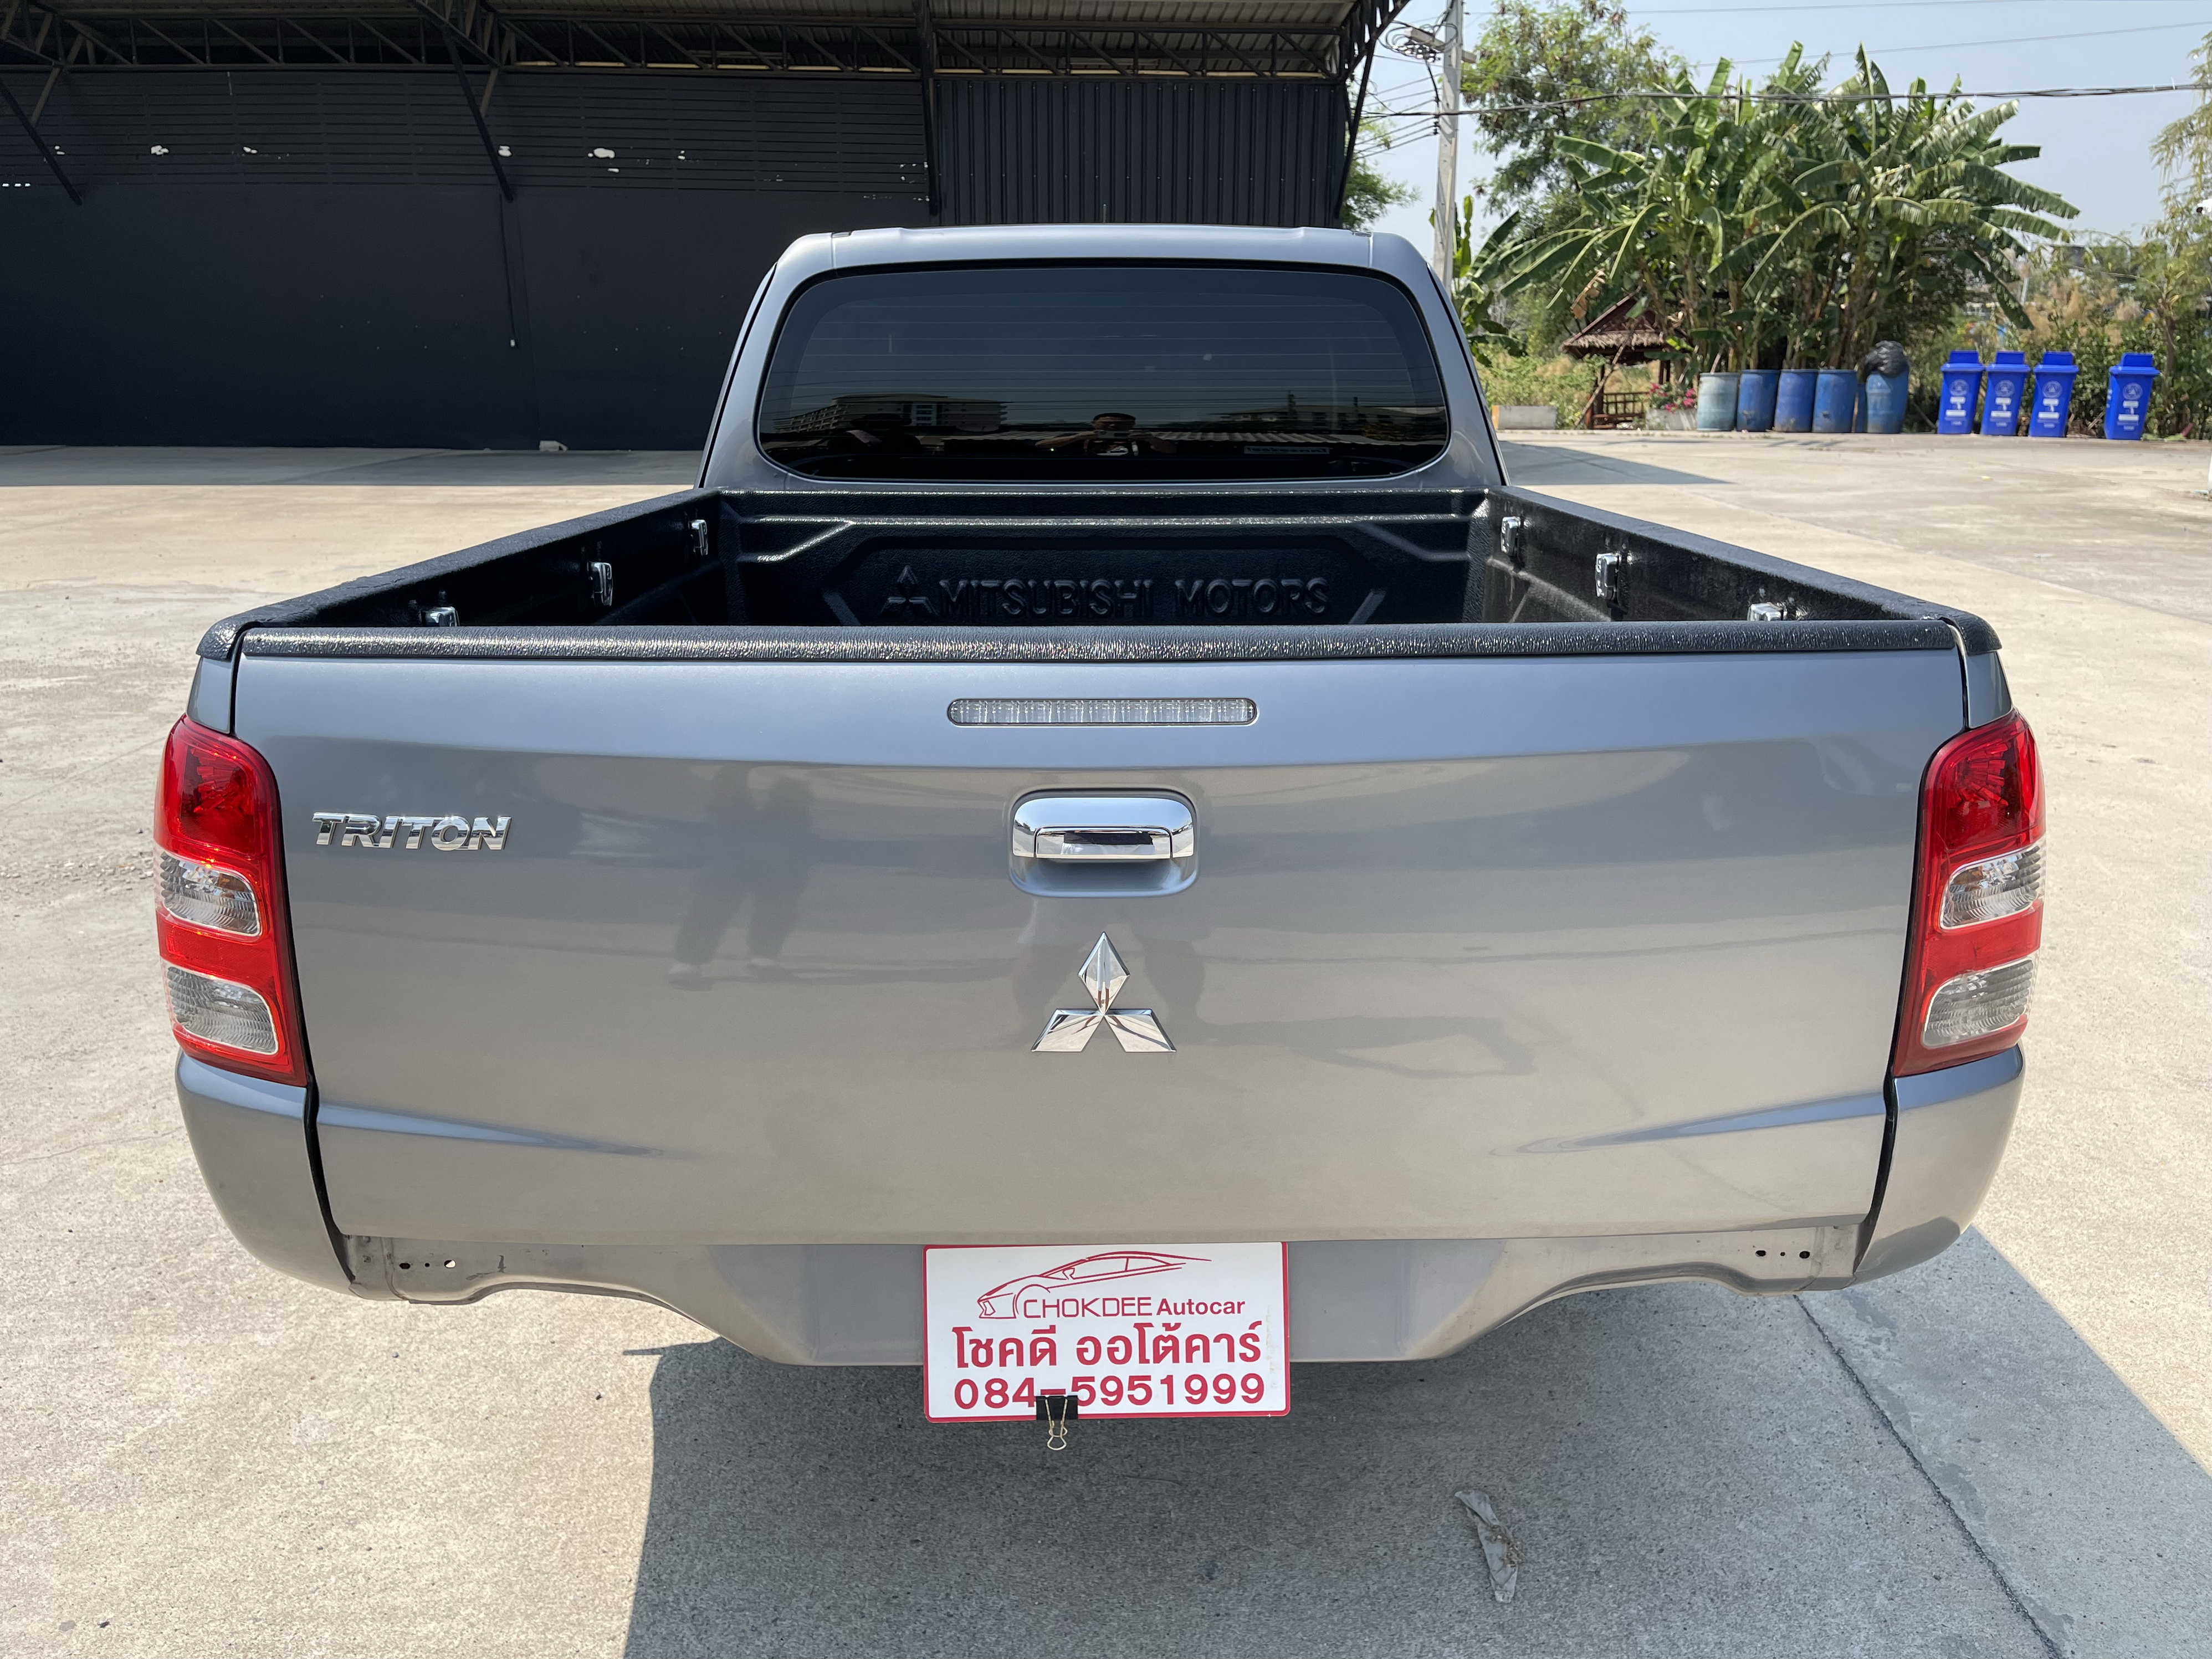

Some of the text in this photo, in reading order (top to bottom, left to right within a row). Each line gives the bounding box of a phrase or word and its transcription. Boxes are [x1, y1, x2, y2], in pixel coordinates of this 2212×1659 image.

[939, 578, 1329, 617] MITSUBISHI MOTORS
[312, 812, 512, 851] TRITON
[1023, 1297, 1246, 1318] CHOKDEE Autocar
[951, 1321, 1262, 1368] โชคดี ออโต้คาร์
[954, 1373, 1265, 1410] 084-5951999
